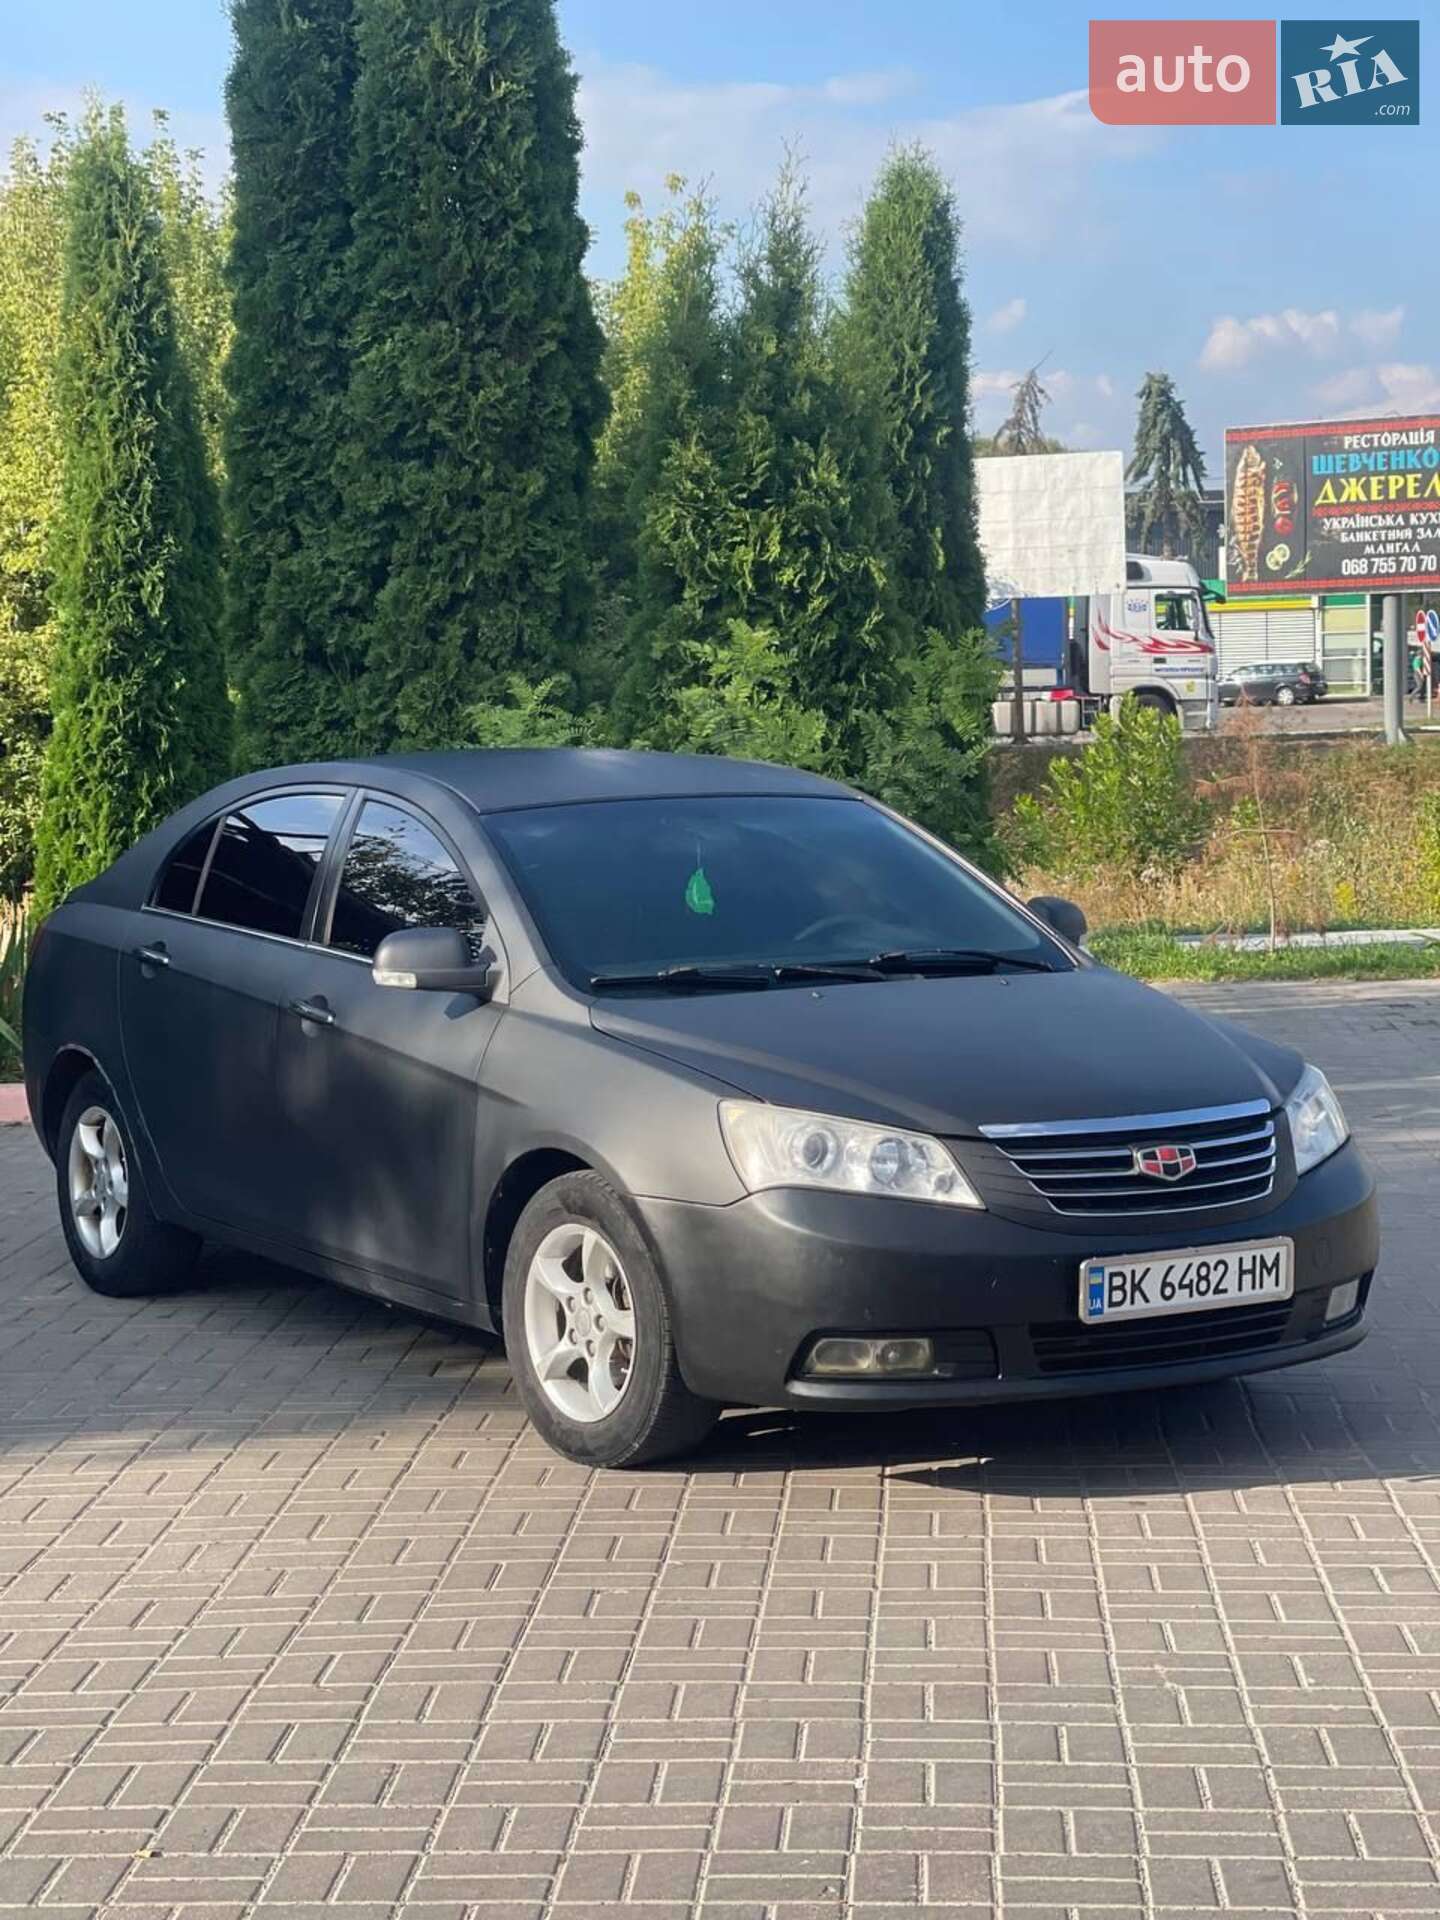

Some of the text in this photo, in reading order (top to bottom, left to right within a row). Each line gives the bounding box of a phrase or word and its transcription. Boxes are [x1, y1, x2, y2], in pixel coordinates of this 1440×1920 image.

[1343, 427, 1436, 449] РЕСТОРАЦІЯ
[1322, 511, 1440, 530] УКРАЇНСЬКА КУХ
[1340, 527, 1412, 543] БАНКЕТНИЙ
[1363, 541, 1421, 555] МАНГАЛ
[1341, 554, 1437, 575] 068 755 70 70
[1160, 1258, 1229, 1302] 6482
